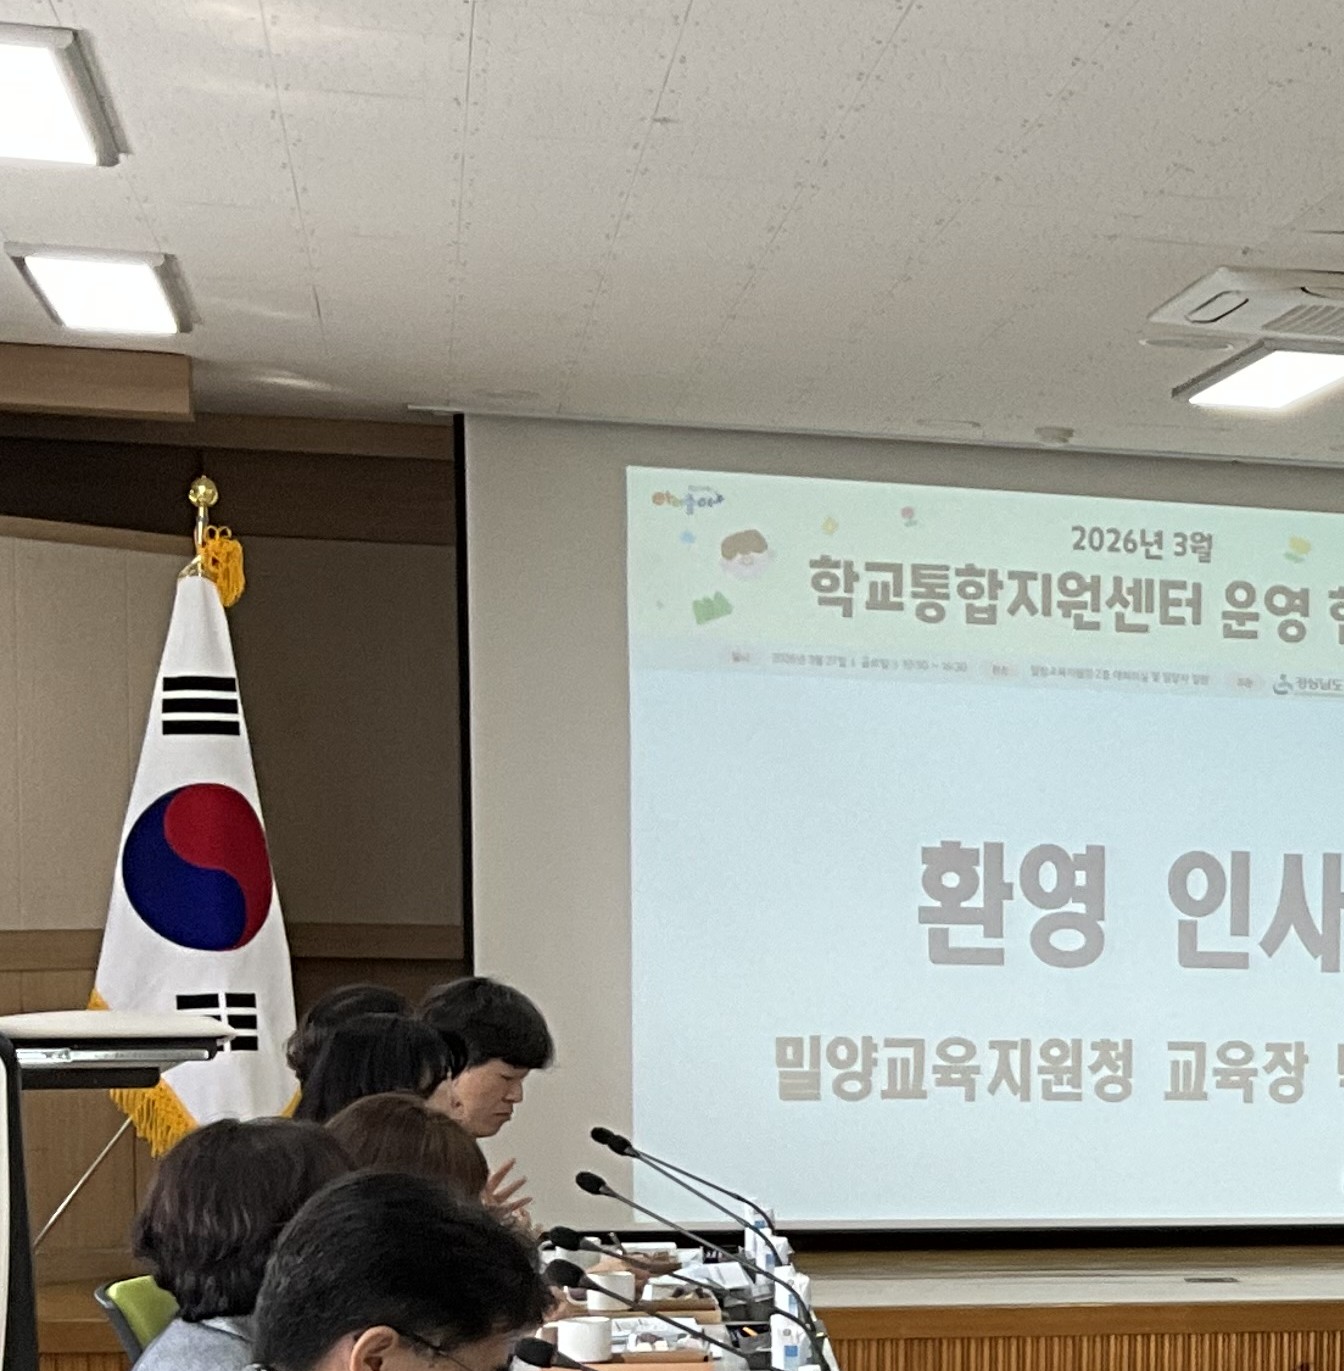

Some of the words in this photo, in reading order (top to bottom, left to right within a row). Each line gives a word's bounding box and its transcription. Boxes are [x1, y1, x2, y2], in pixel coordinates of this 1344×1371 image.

[1071, 525, 1165, 561] 2026년
[1173, 531, 1214, 563] 3월
[808, 554, 1202, 634] 학교통합지원센터
[1221, 579, 1311, 644] 운영
[918, 839, 1106, 969] 환영
[775, 1034, 1134, 1103] 밀양교육지원청
[1164, 1040, 1309, 1105] 교육장
